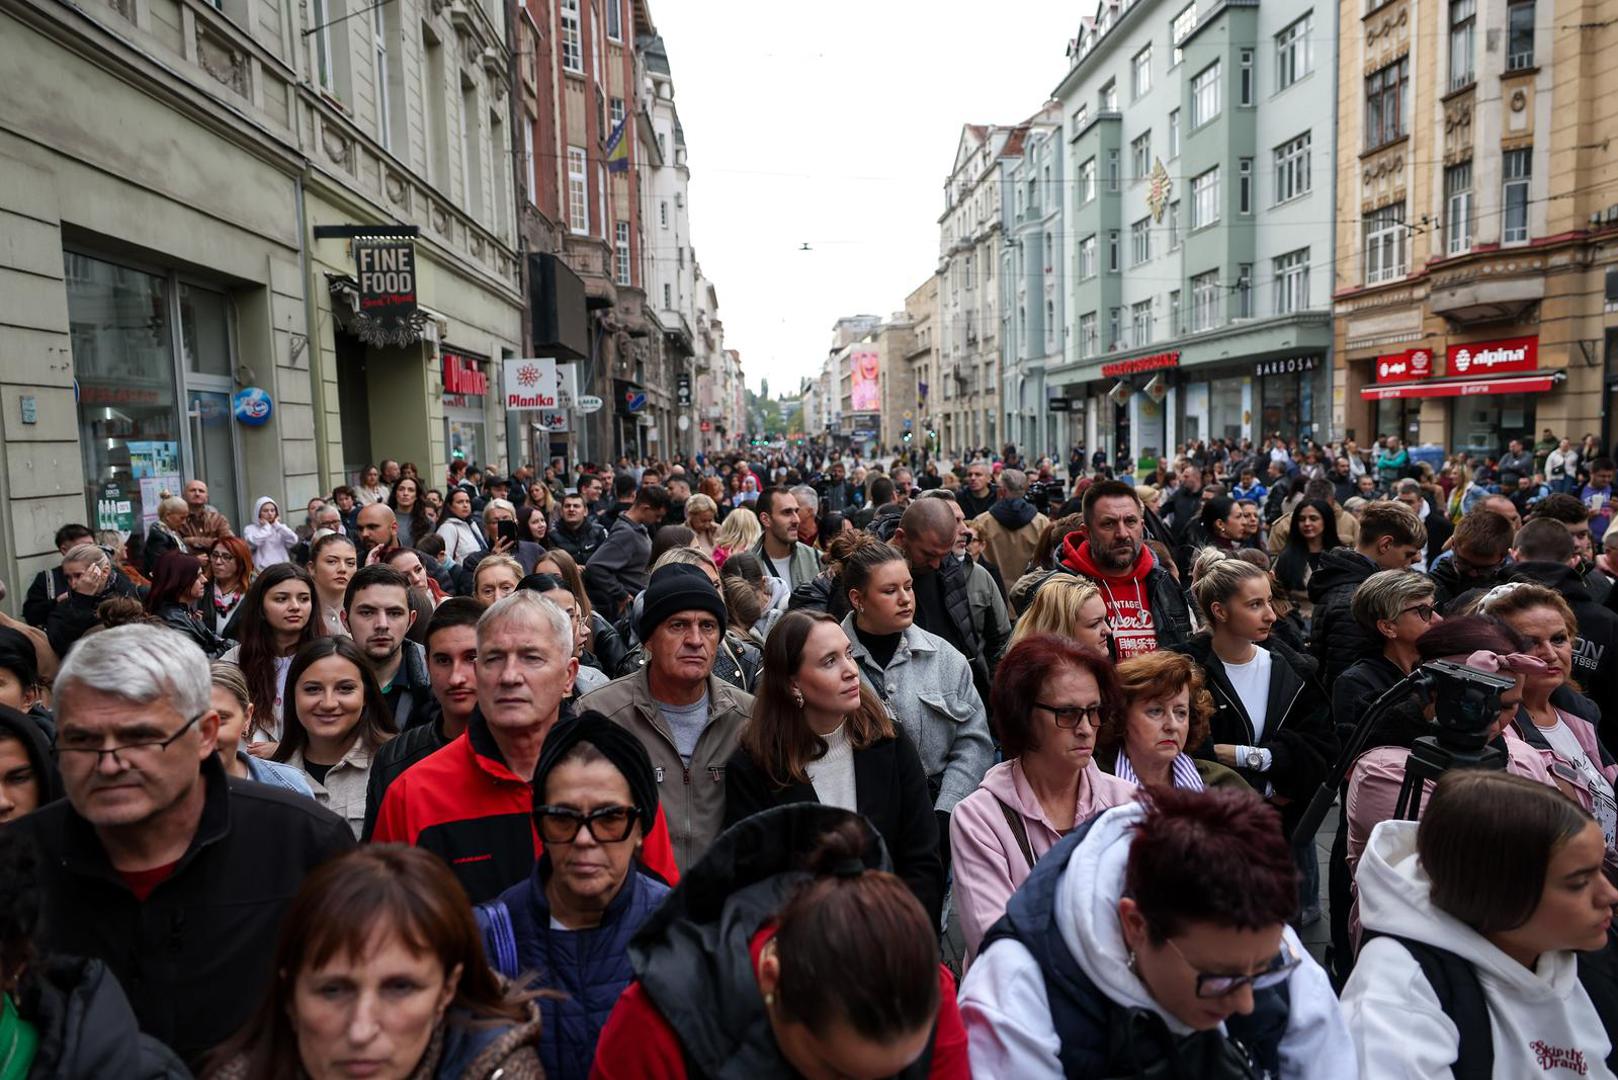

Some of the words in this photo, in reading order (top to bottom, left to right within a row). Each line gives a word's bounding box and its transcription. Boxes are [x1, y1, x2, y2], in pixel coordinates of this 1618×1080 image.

[360, 248, 411, 271] FINE
[361, 272, 412, 293] FOOD
[1256, 357, 1313, 376] BARBOSA
[1472, 348, 1526, 367] alpina
[508, 393, 554, 407] Planika
[1573, 656, 1599, 670] 1999
[1529, 1039, 1564, 1058] Skip
